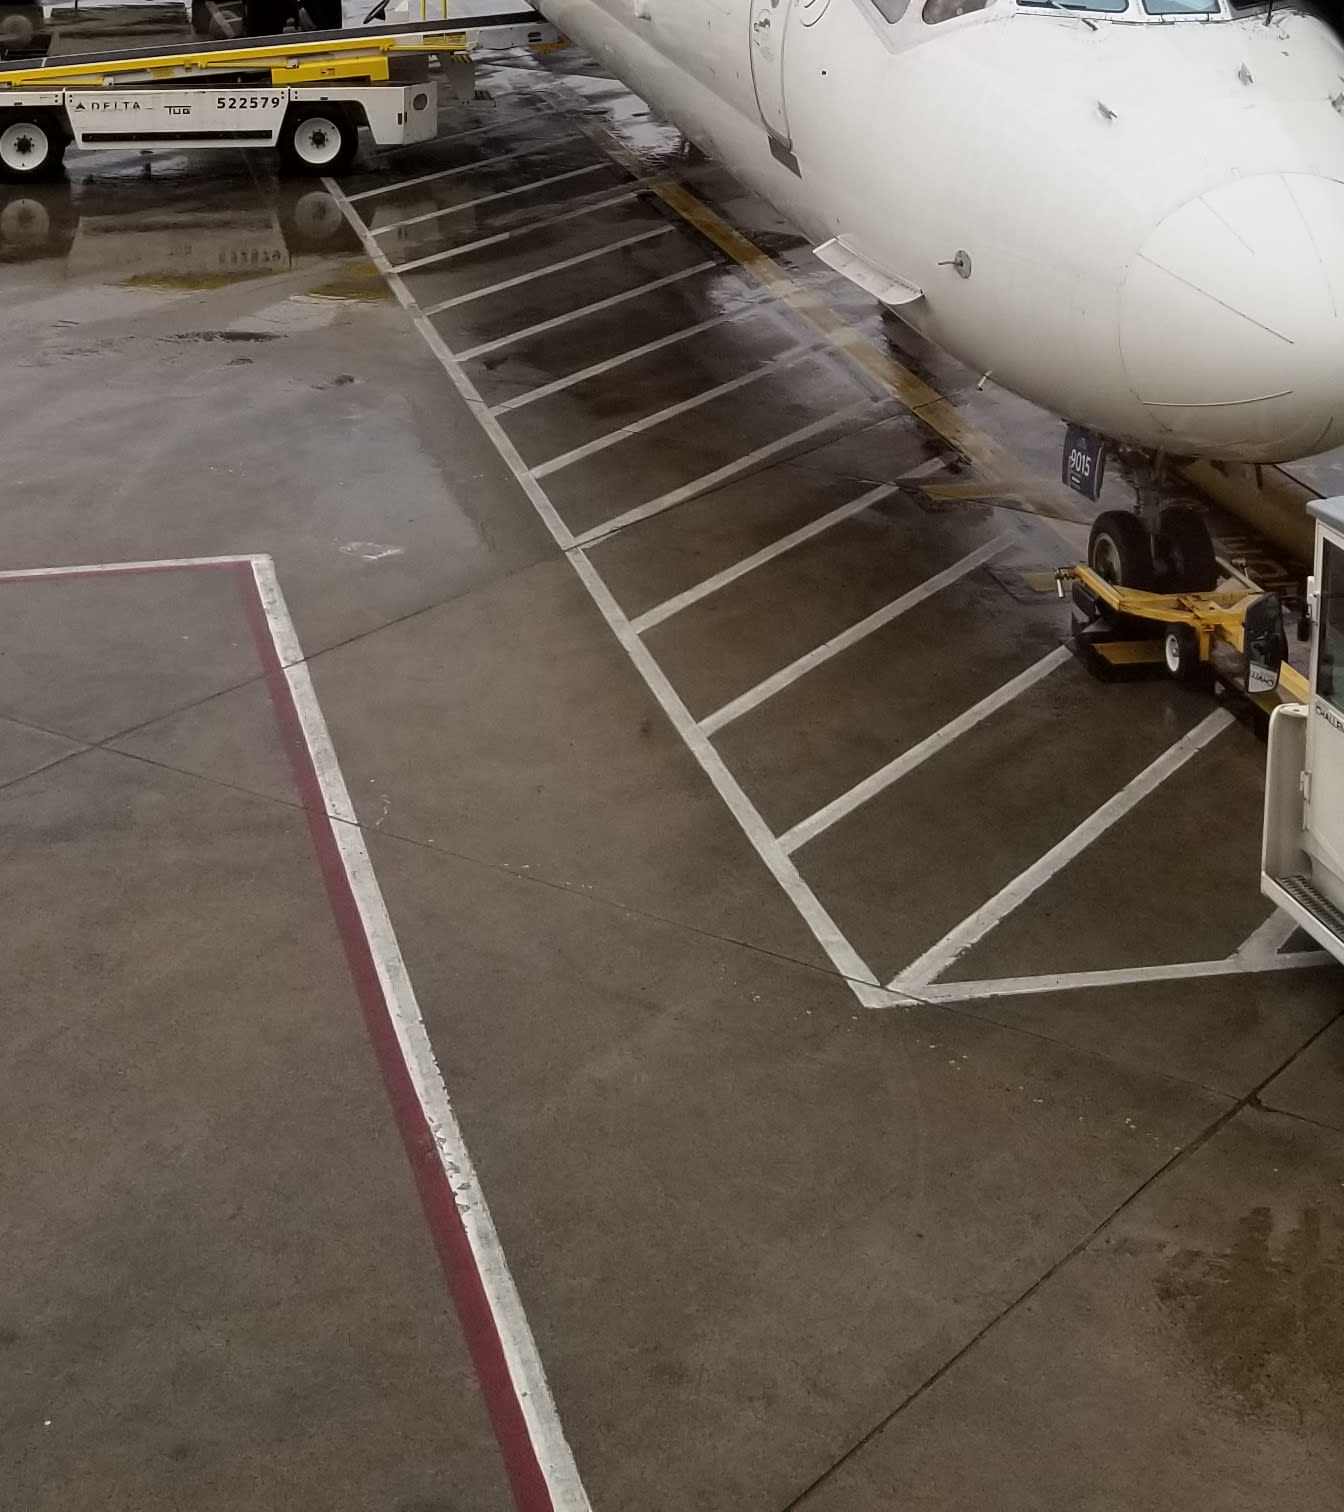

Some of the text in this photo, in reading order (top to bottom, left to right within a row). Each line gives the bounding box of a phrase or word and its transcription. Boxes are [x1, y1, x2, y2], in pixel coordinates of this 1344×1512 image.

[91, 101, 141, 111] DELTA
[216, 96, 280, 109] 522579
[1069, 449, 1092, 477] 9015
